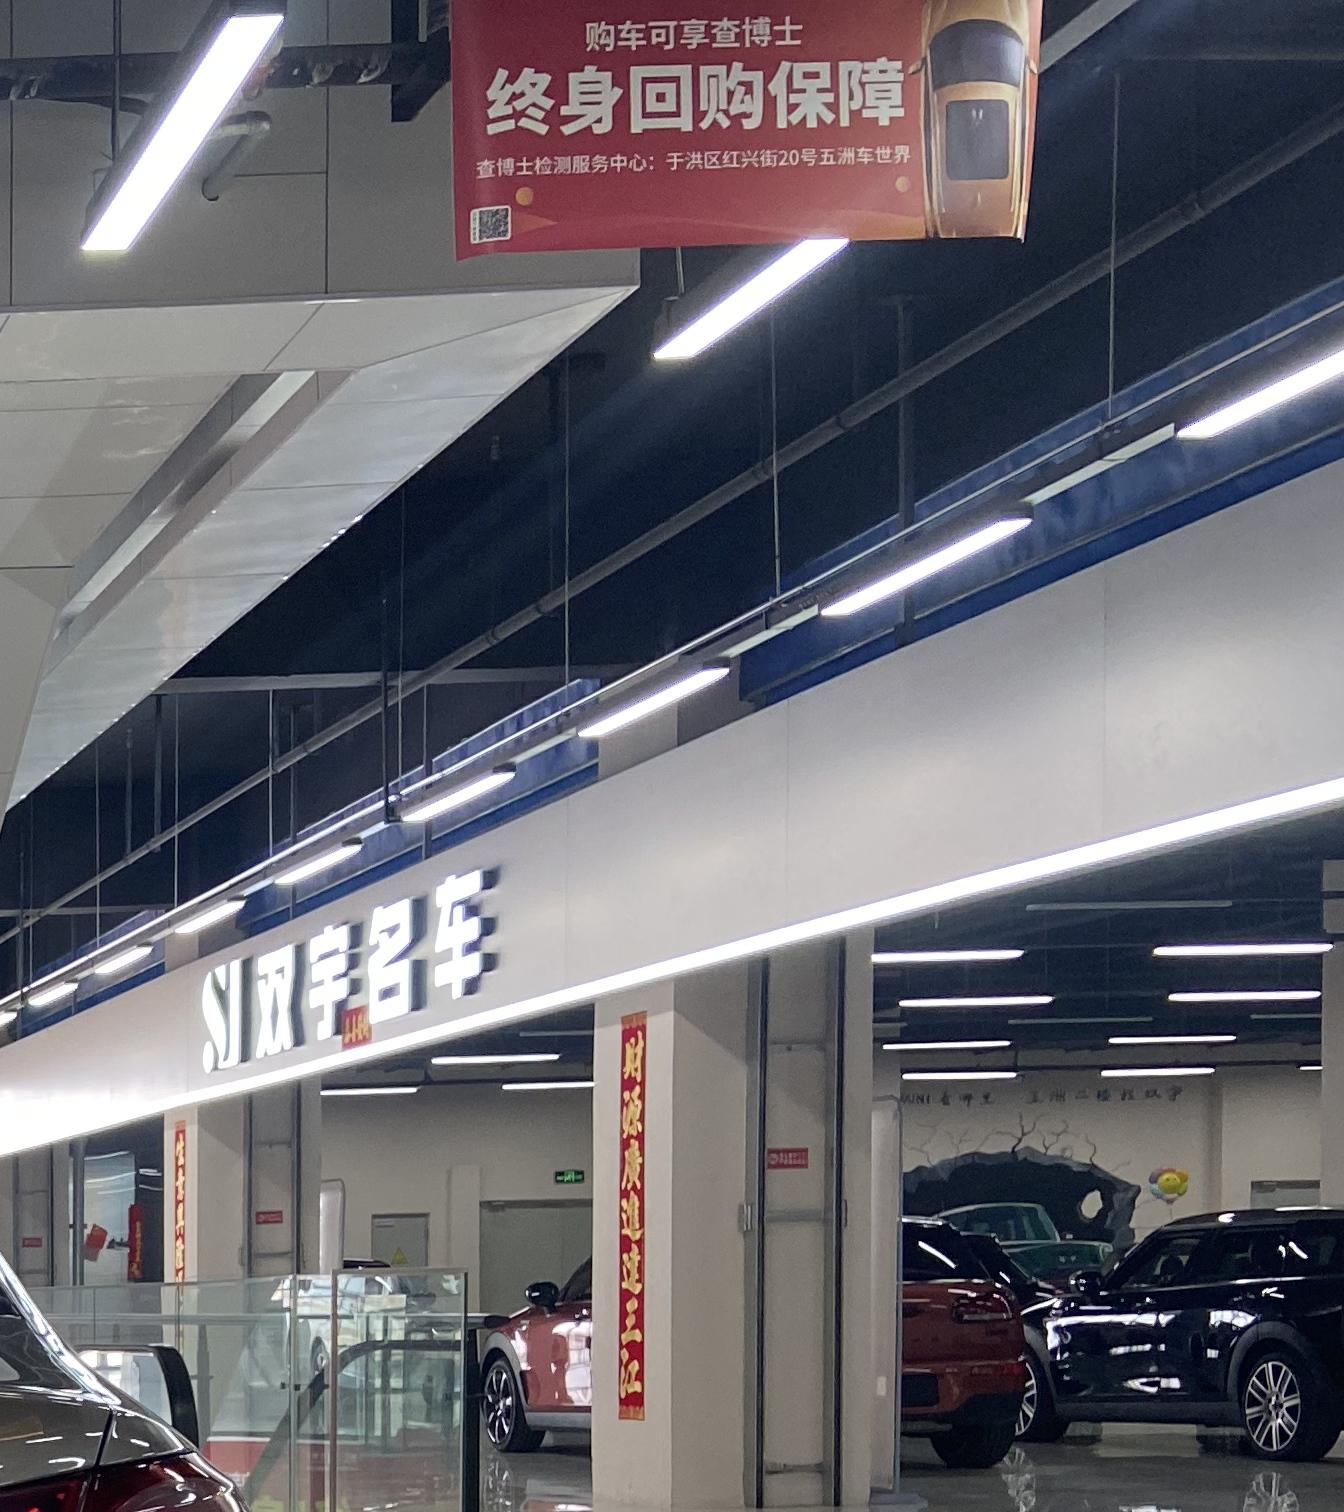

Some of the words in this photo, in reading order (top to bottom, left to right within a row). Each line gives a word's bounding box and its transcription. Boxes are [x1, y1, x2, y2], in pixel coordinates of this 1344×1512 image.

[584, 17, 803, 52] 购车可享查博士
[486, 57, 906, 137] 终身回购保障
[256, 869, 485, 1060] 双宇名车
